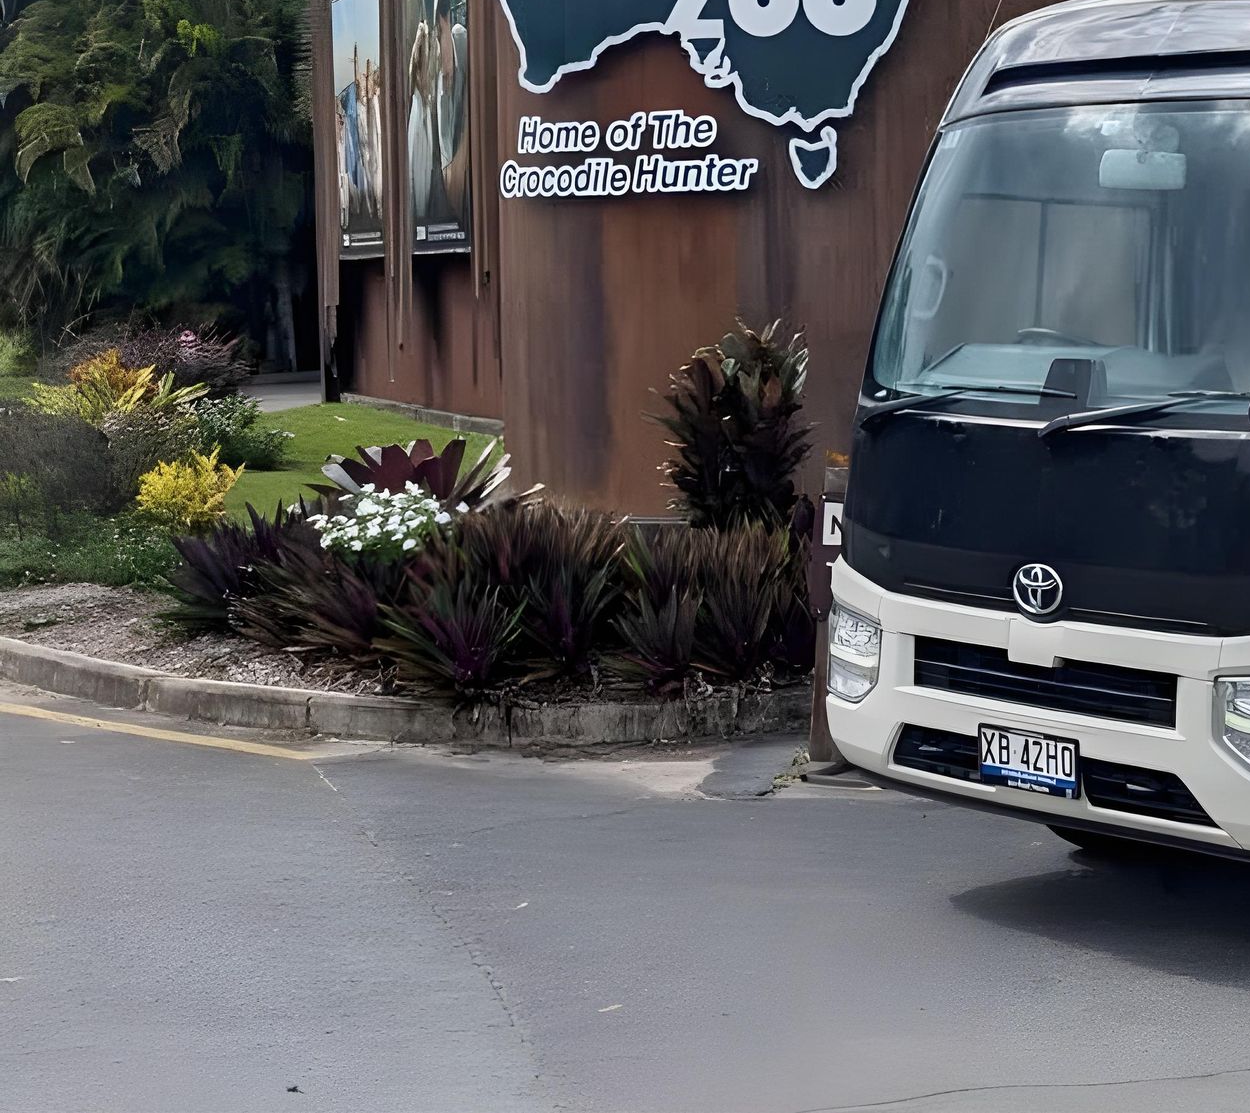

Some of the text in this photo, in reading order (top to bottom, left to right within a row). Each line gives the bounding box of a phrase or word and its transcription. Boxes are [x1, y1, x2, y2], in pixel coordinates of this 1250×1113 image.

[518, 109, 717, 153] Home of The
[500, 154, 759, 199] Crocodile Hunter
[982, 731, 1010, 765] XB
